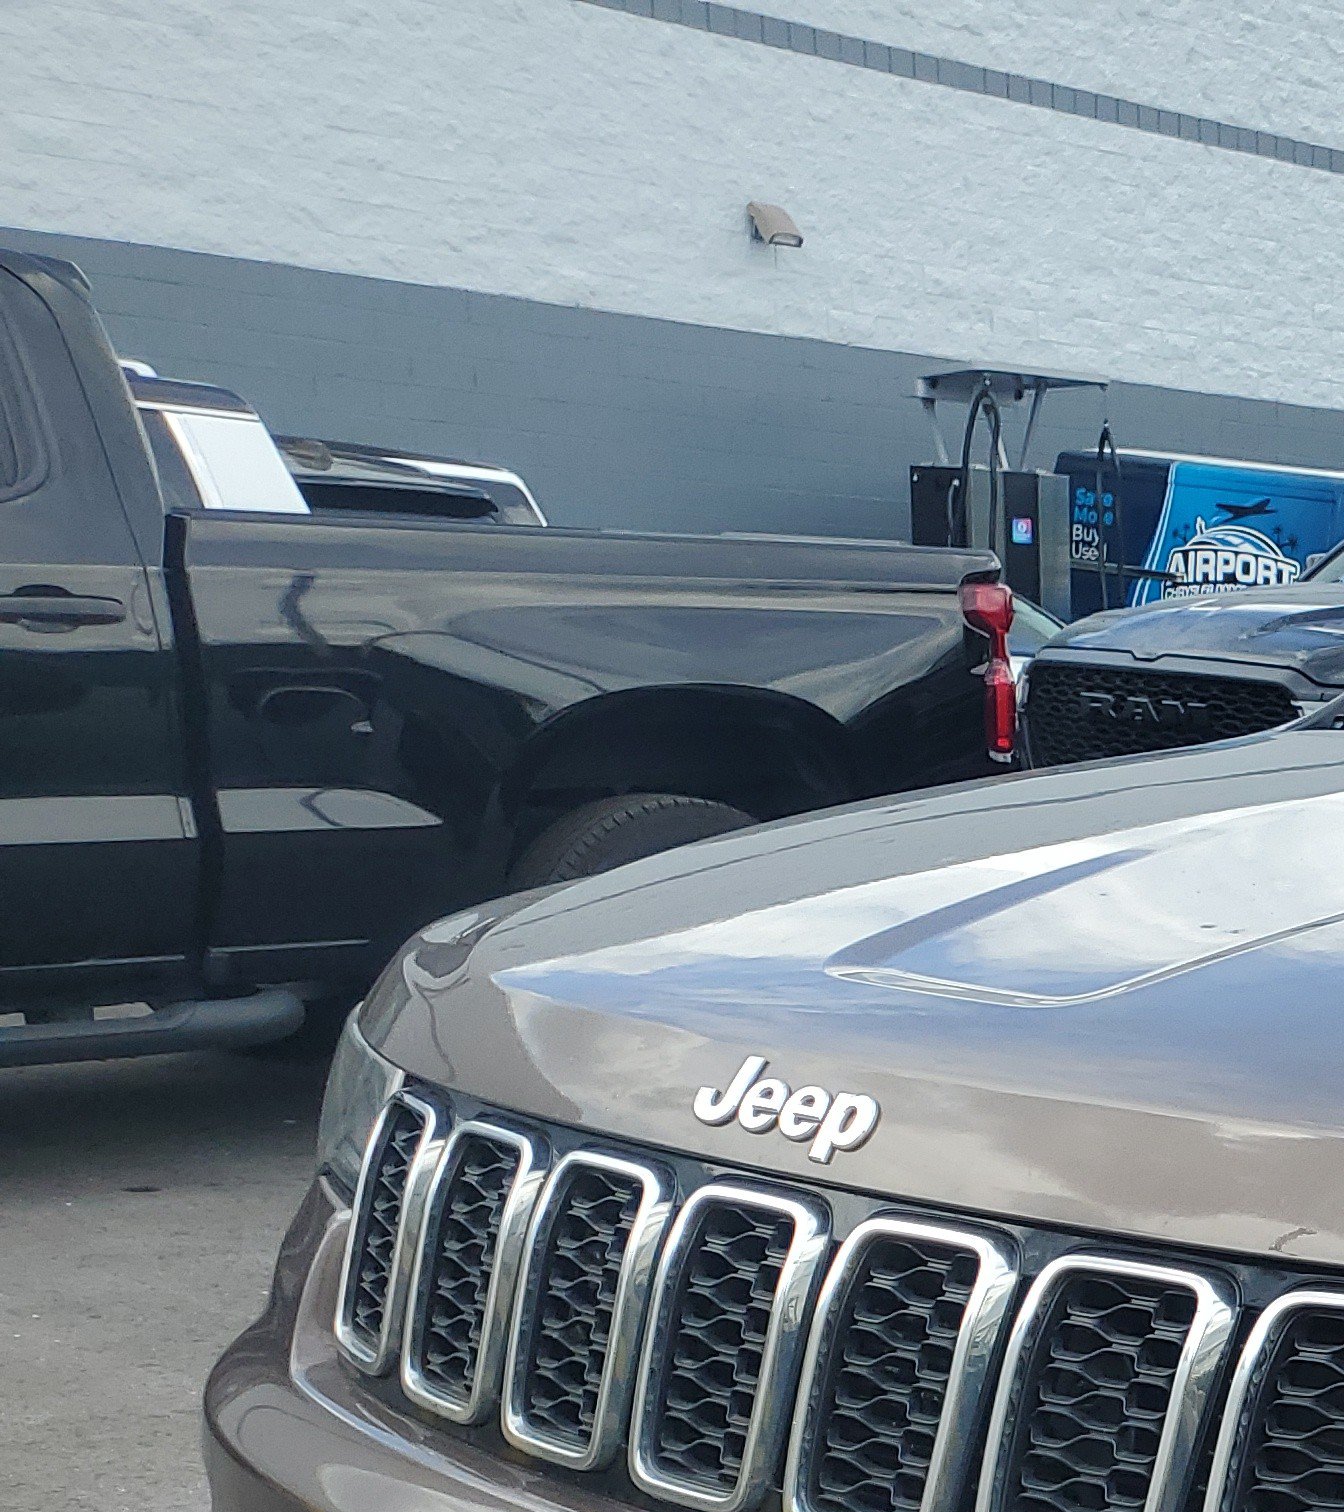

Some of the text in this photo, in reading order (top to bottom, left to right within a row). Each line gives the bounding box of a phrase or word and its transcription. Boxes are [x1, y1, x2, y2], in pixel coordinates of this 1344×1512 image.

[1075, 487, 1114, 508] Sae
[1073, 505, 1114, 525] Moe
[1072, 524, 1100, 546] Buy
[1168, 550, 1297, 585] AIRPORT
[693, 1055, 881, 1165] Jeep
